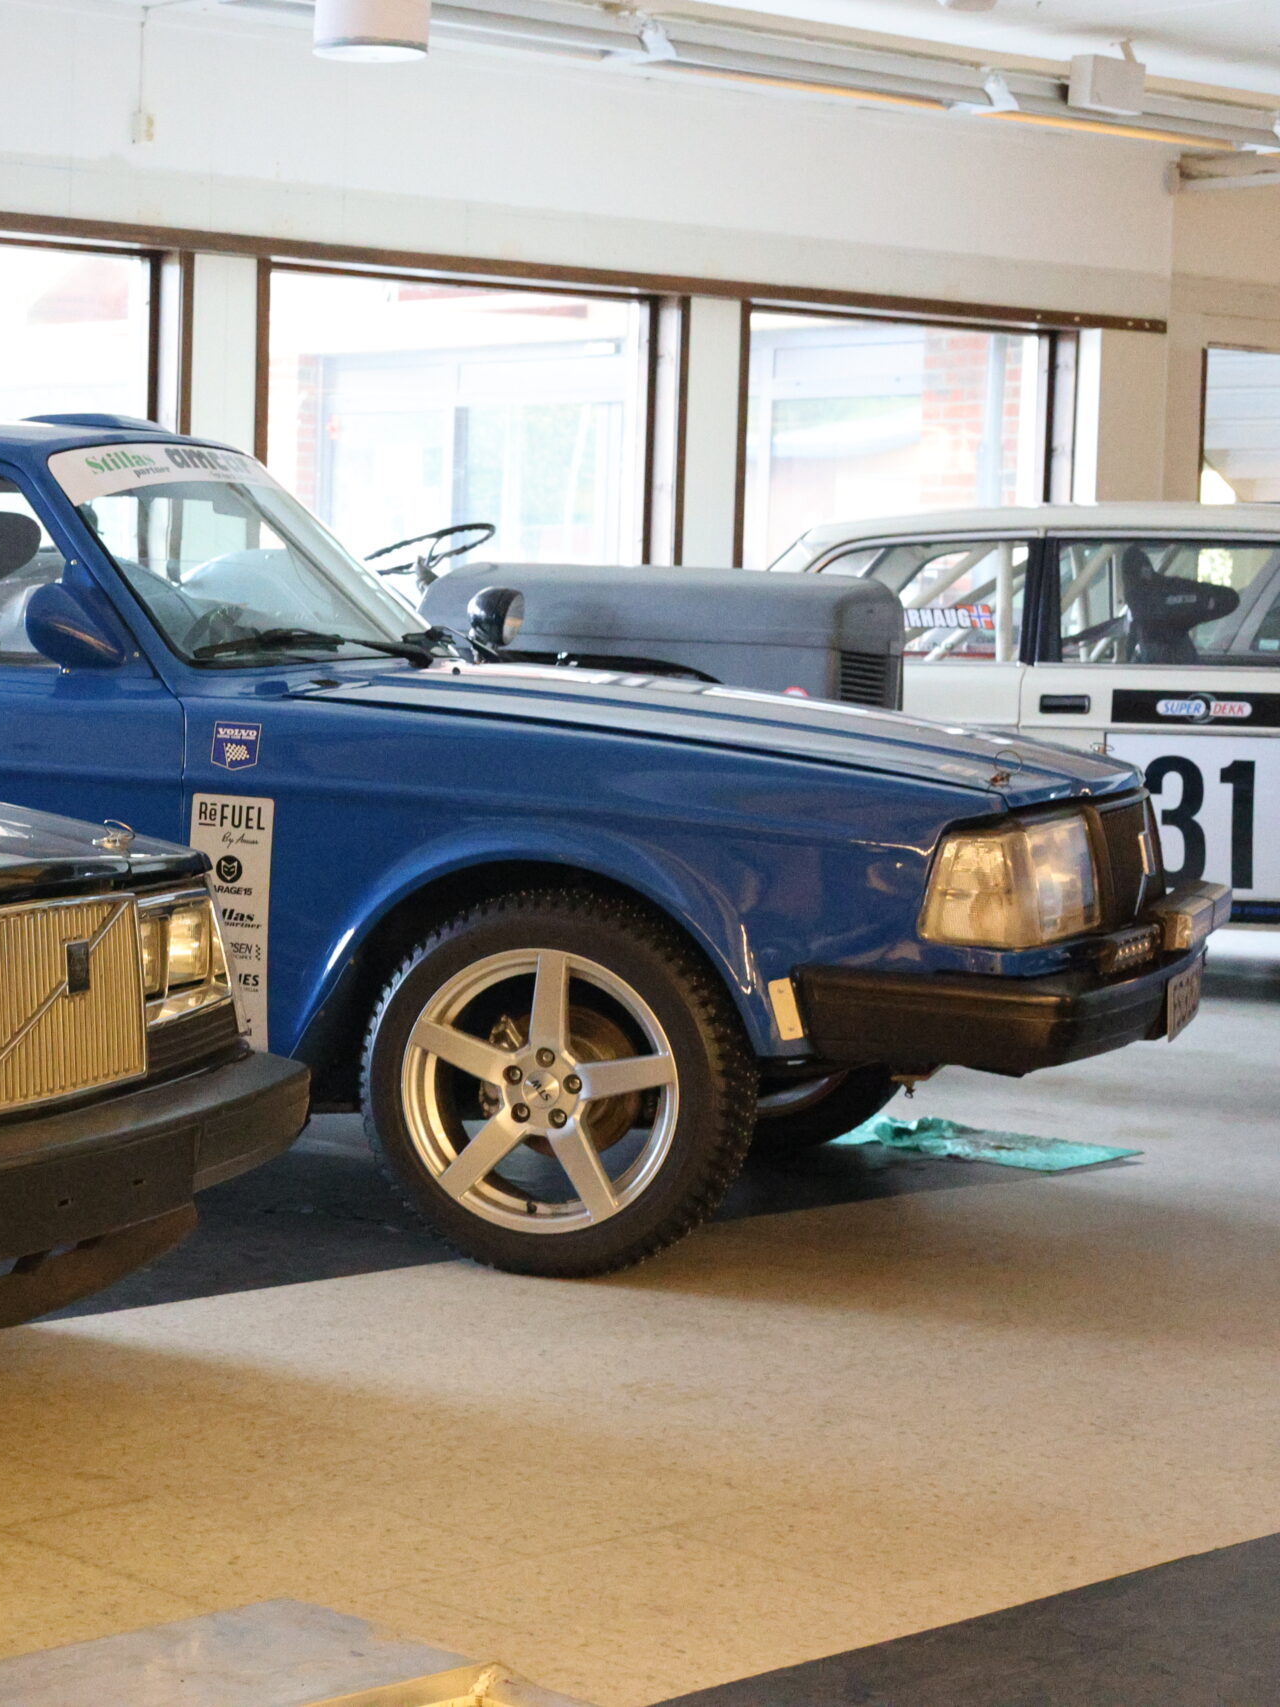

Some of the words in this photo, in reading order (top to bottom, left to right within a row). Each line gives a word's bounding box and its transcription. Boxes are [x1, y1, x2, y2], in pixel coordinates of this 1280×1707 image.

[85, 451, 156, 475] Stillas
[133, 464, 170, 479] partner
[1163, 701, 1202, 715] SUPER
[1212, 702, 1247, 716] DEKK
[218, 727, 257, 736] VOLVO
[1144, 754, 1256, 890] 31
